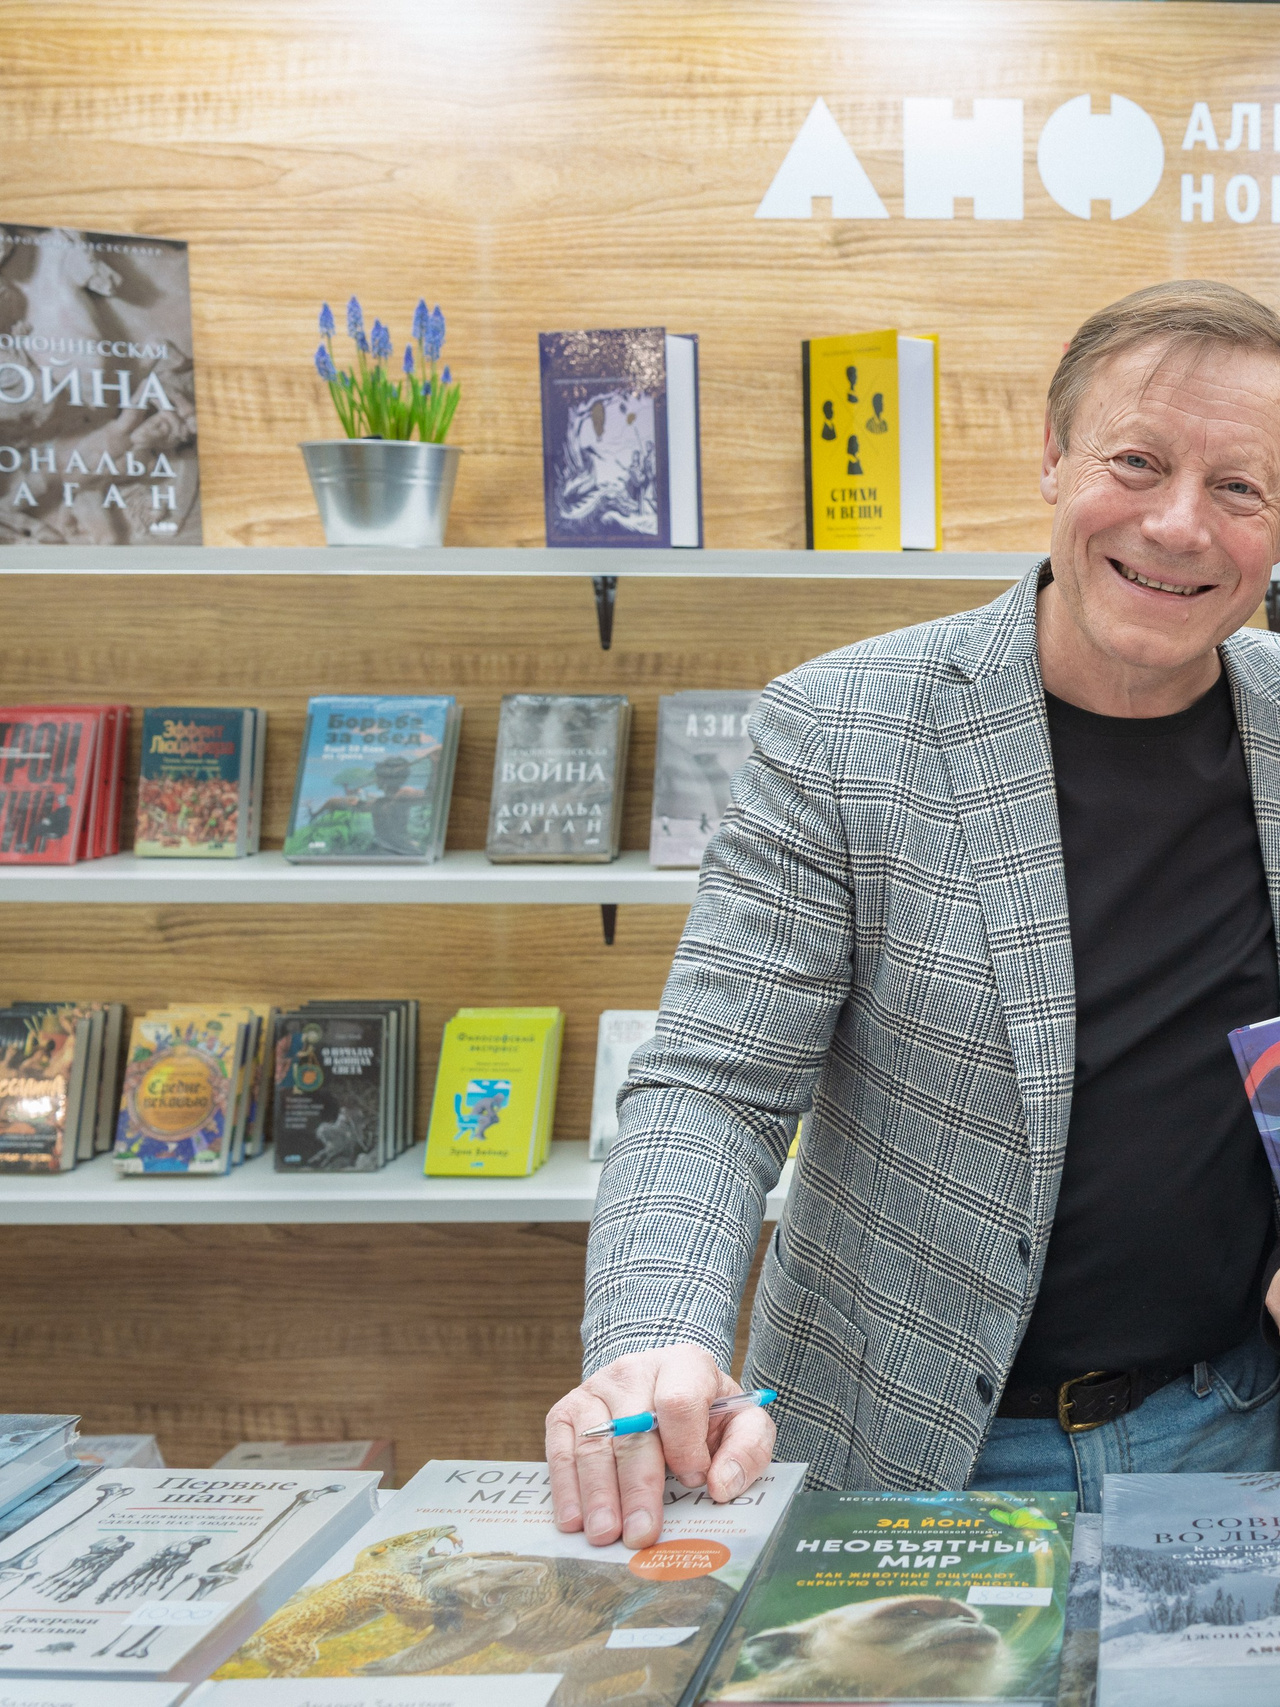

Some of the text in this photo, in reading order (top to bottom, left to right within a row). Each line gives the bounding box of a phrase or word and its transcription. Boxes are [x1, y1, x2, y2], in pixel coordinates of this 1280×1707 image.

[830, 486, 878, 503] СТИХИ
[826, 505, 884, 520] И ВЕЩИ
[327, 713, 424, 731] Борьба
[362, 731, 423, 746] обед
[501, 757, 606, 783] ВОЙНА
[497, 801, 603, 818] ДОНАЛЬД
[495, 819, 601, 835] КАГАН
[153, 1477, 298, 1494] Первые
[158, 1493, 260, 1504] шаги
[876, 1517, 985, 1529] ЭД ЙОНГ
[796, 1537, 1051, 1553] НЕОБЪЯТНЫЙ
[1155, 1531, 1204, 1544] ВО
[640, 1561, 712, 1569] ШАУТЕНА
[877, 1555, 962, 1569] МИР
[937, 1572, 1015, 1580] ОЩУЩАЮТ
[935, 1580, 1029, 1588] РЕАЛЬНОСТЬ
[7, 1615, 100, 1626] Джереми
